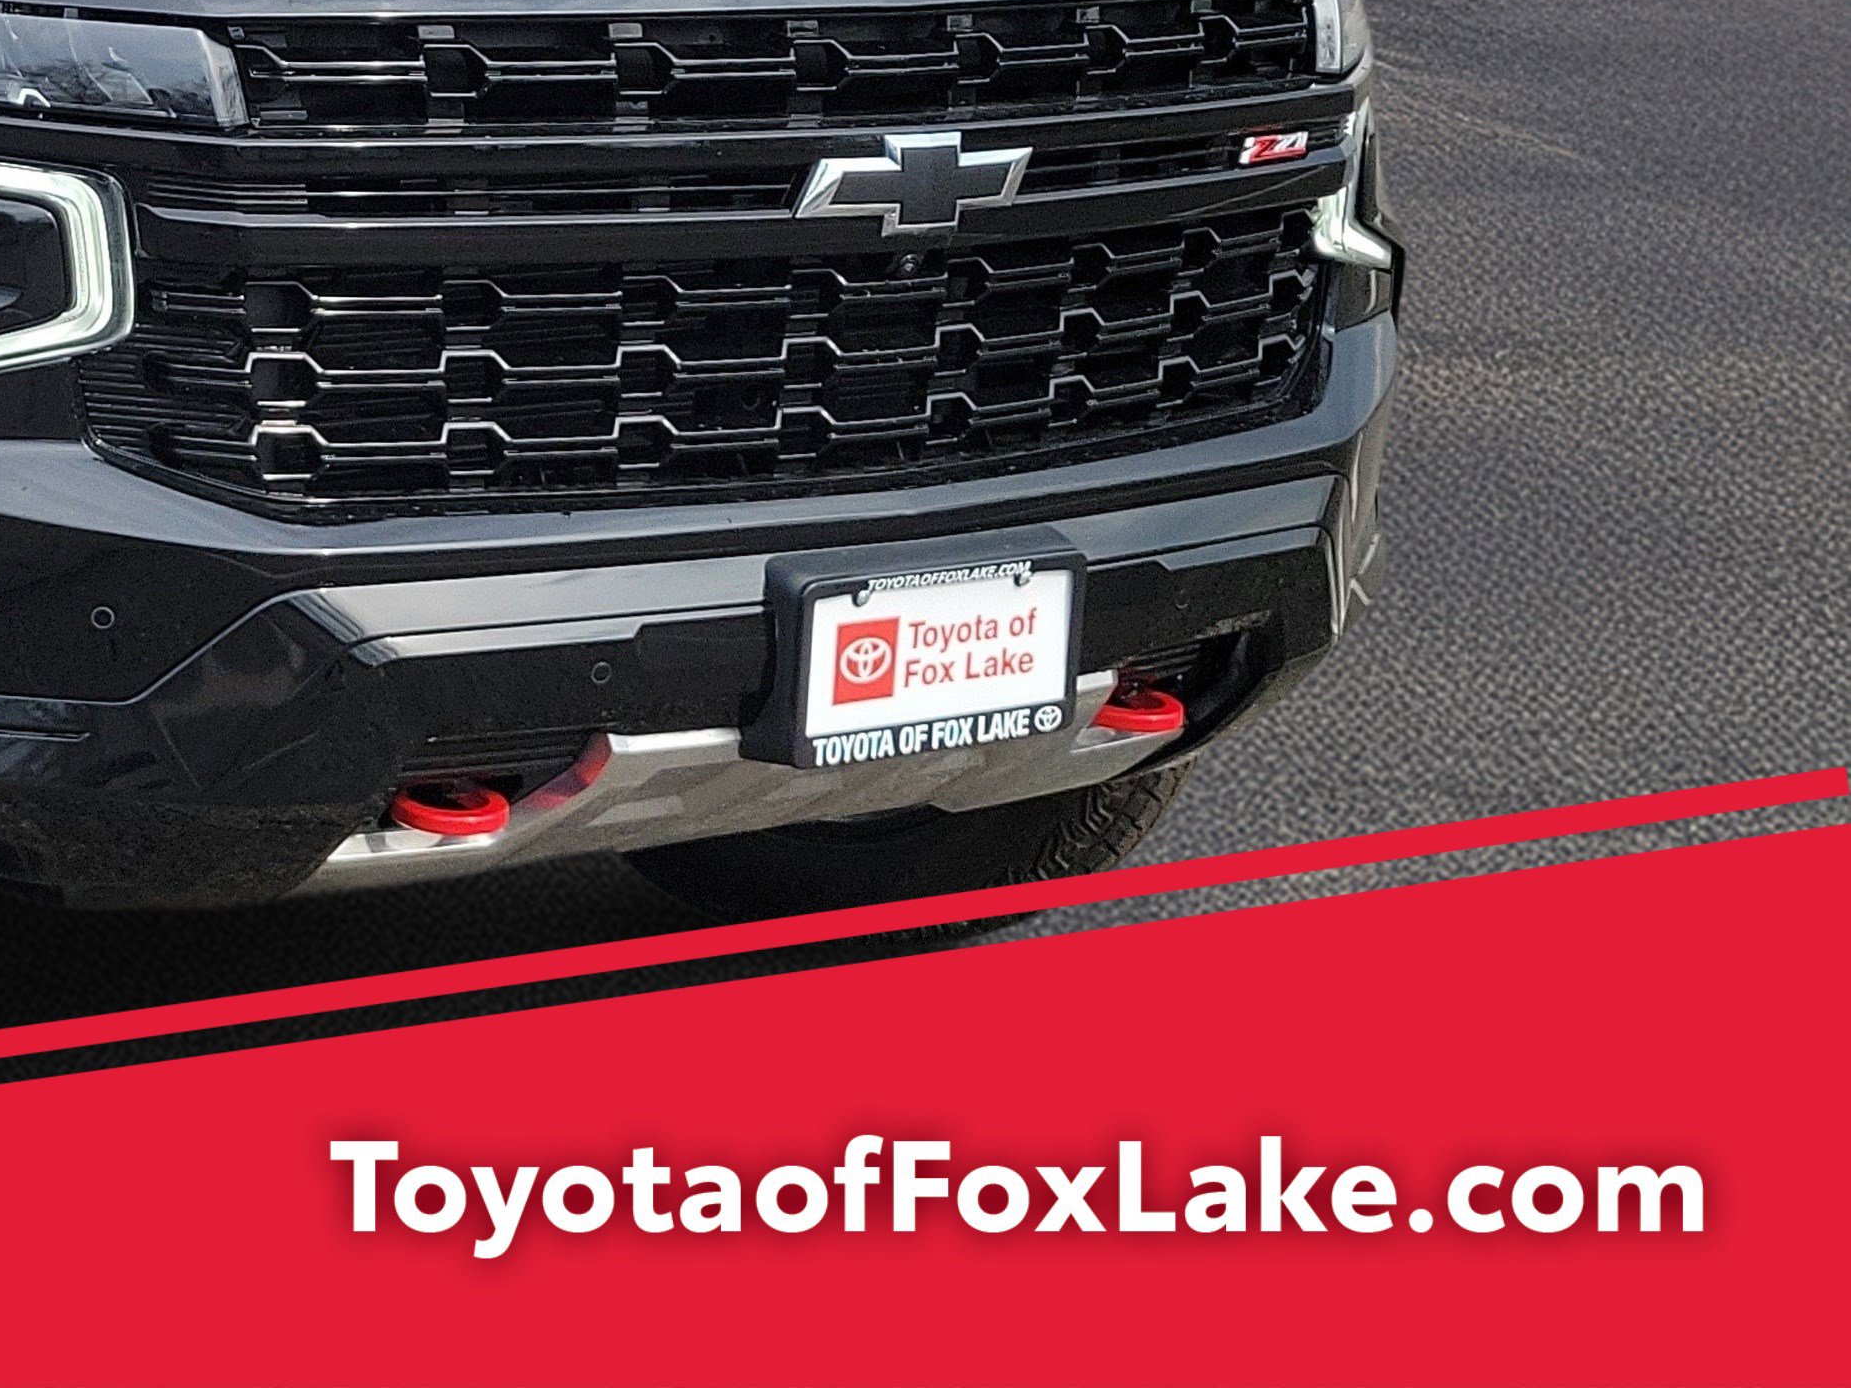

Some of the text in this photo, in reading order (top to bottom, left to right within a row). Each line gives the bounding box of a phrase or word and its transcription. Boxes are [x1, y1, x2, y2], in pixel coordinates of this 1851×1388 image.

[867, 561, 1032, 592] TOYOTAOFFOXLAKE.COM
[908, 607, 1038, 653] Toyota of
[903, 648, 1035, 688] Fox Lake
[813, 708, 1031, 767] TOYOTA OF FOX LAKE
